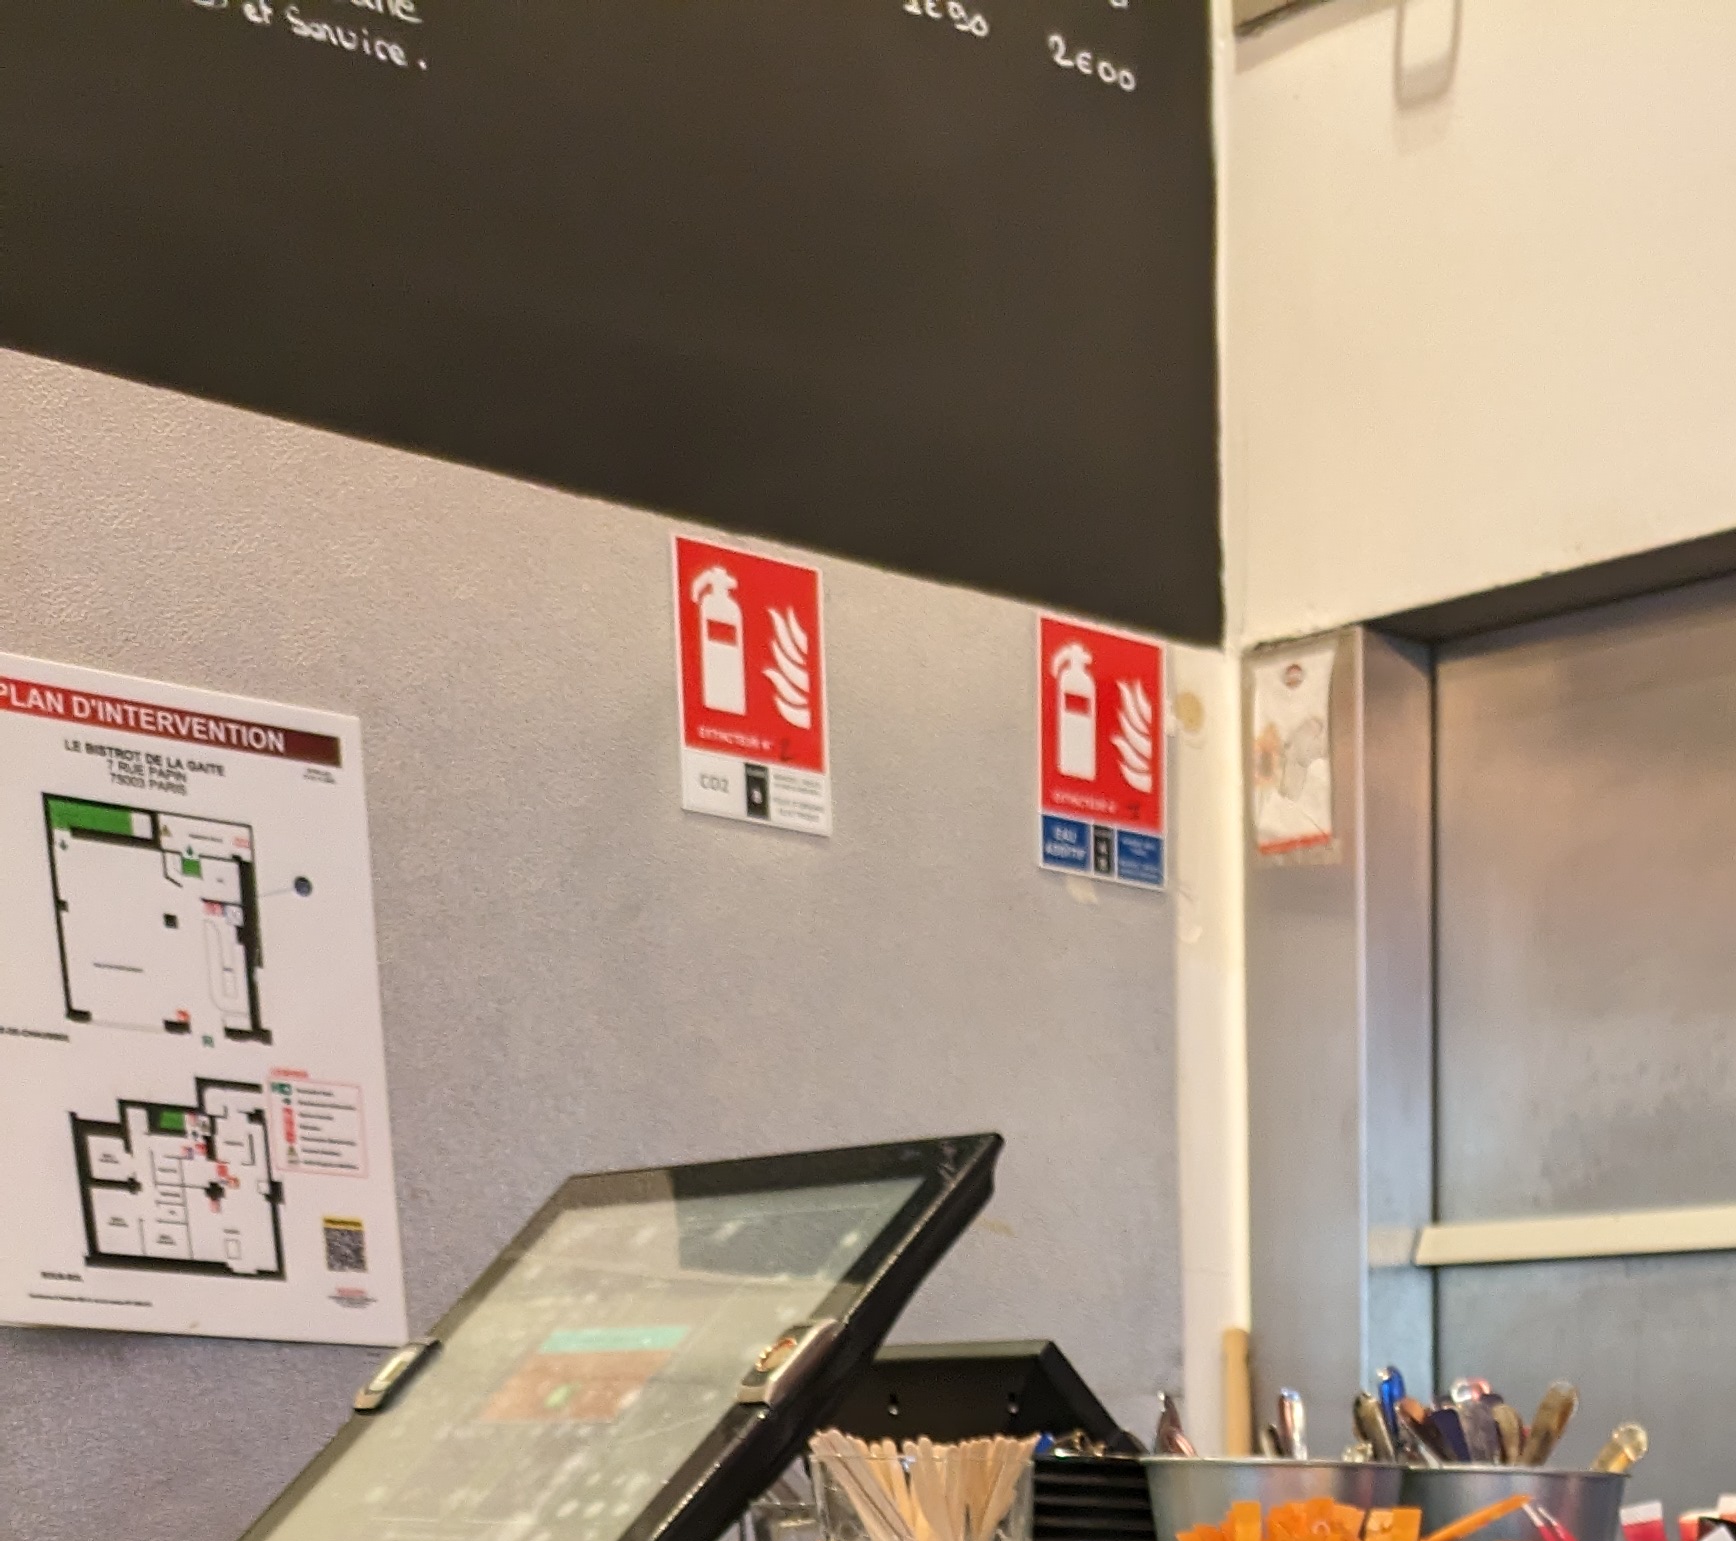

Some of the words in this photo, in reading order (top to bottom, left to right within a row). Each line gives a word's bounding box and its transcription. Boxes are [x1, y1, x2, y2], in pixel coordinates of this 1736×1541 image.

[72, 694, 286, 753] D'INTERVENTION
[64, 739, 81, 753] LE
[85, 742, 142, 762] BISTROT
[145, 752, 163, 766] DE
[166, 756, 185, 770] LA
[118, 760, 145, 776] RUE
